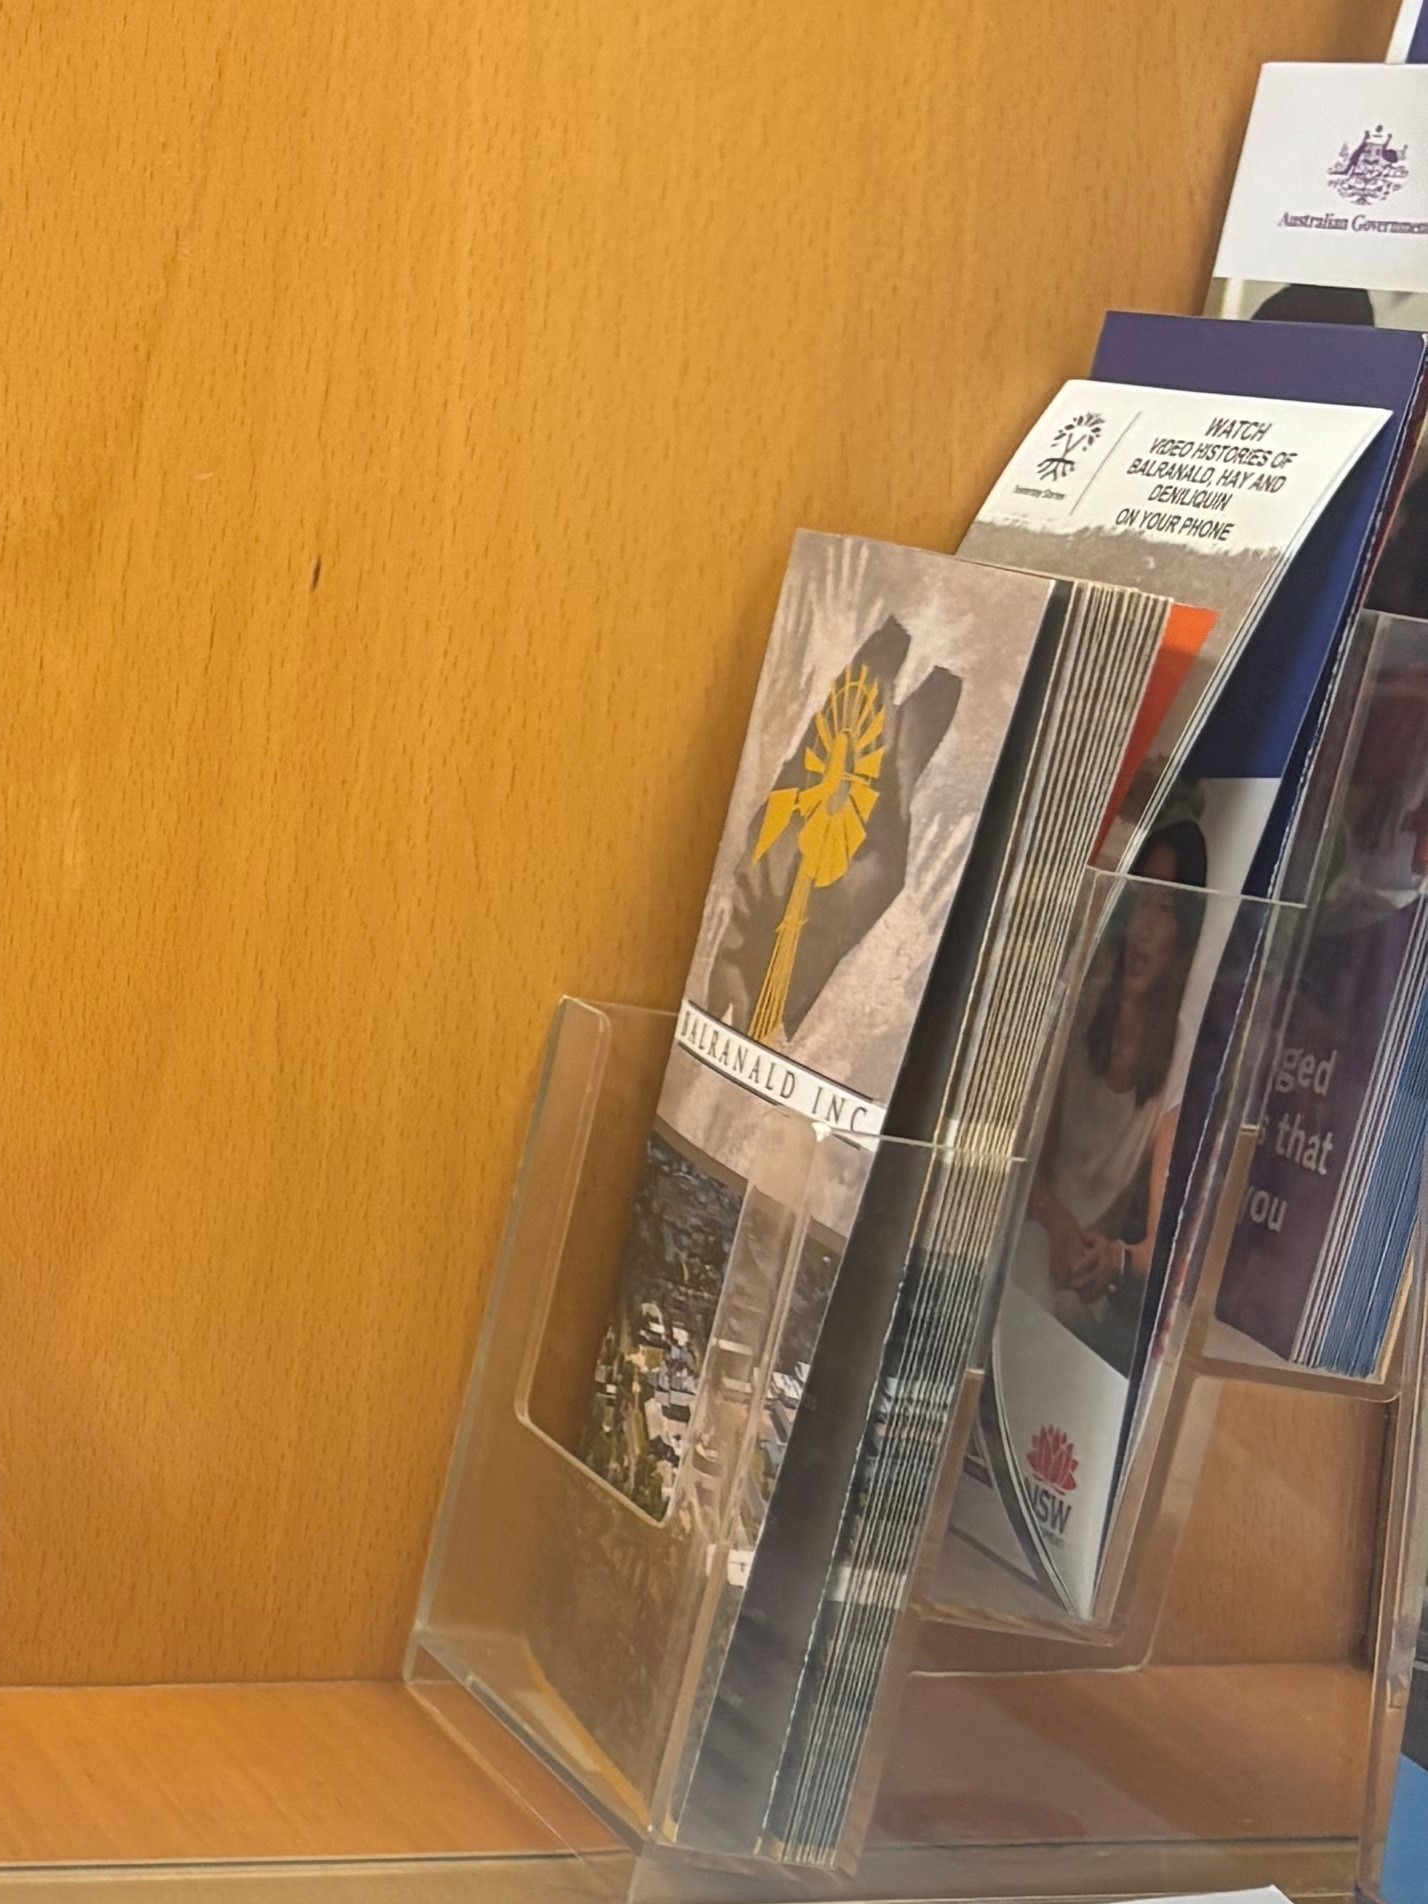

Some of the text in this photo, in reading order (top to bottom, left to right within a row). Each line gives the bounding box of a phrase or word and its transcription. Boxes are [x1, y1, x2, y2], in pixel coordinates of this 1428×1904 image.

[1278, 211, 1428, 234] Australian Governmen
[1204, 417, 1273, 442] WATCH
[1149, 437, 1298, 469] VIDEO HISTORIES OF
[1127, 458, 1287, 493] BALRANALD, HAY AND
[1148, 484, 1234, 511] DENILIQUIN
[1115, 508, 1235, 542] ON YOUR PHONE
[680, 1010, 796, 1100] BALRANALD
[1273, 1047, 1337, 1096] ged
[1275, 1113, 1333, 1176] that
